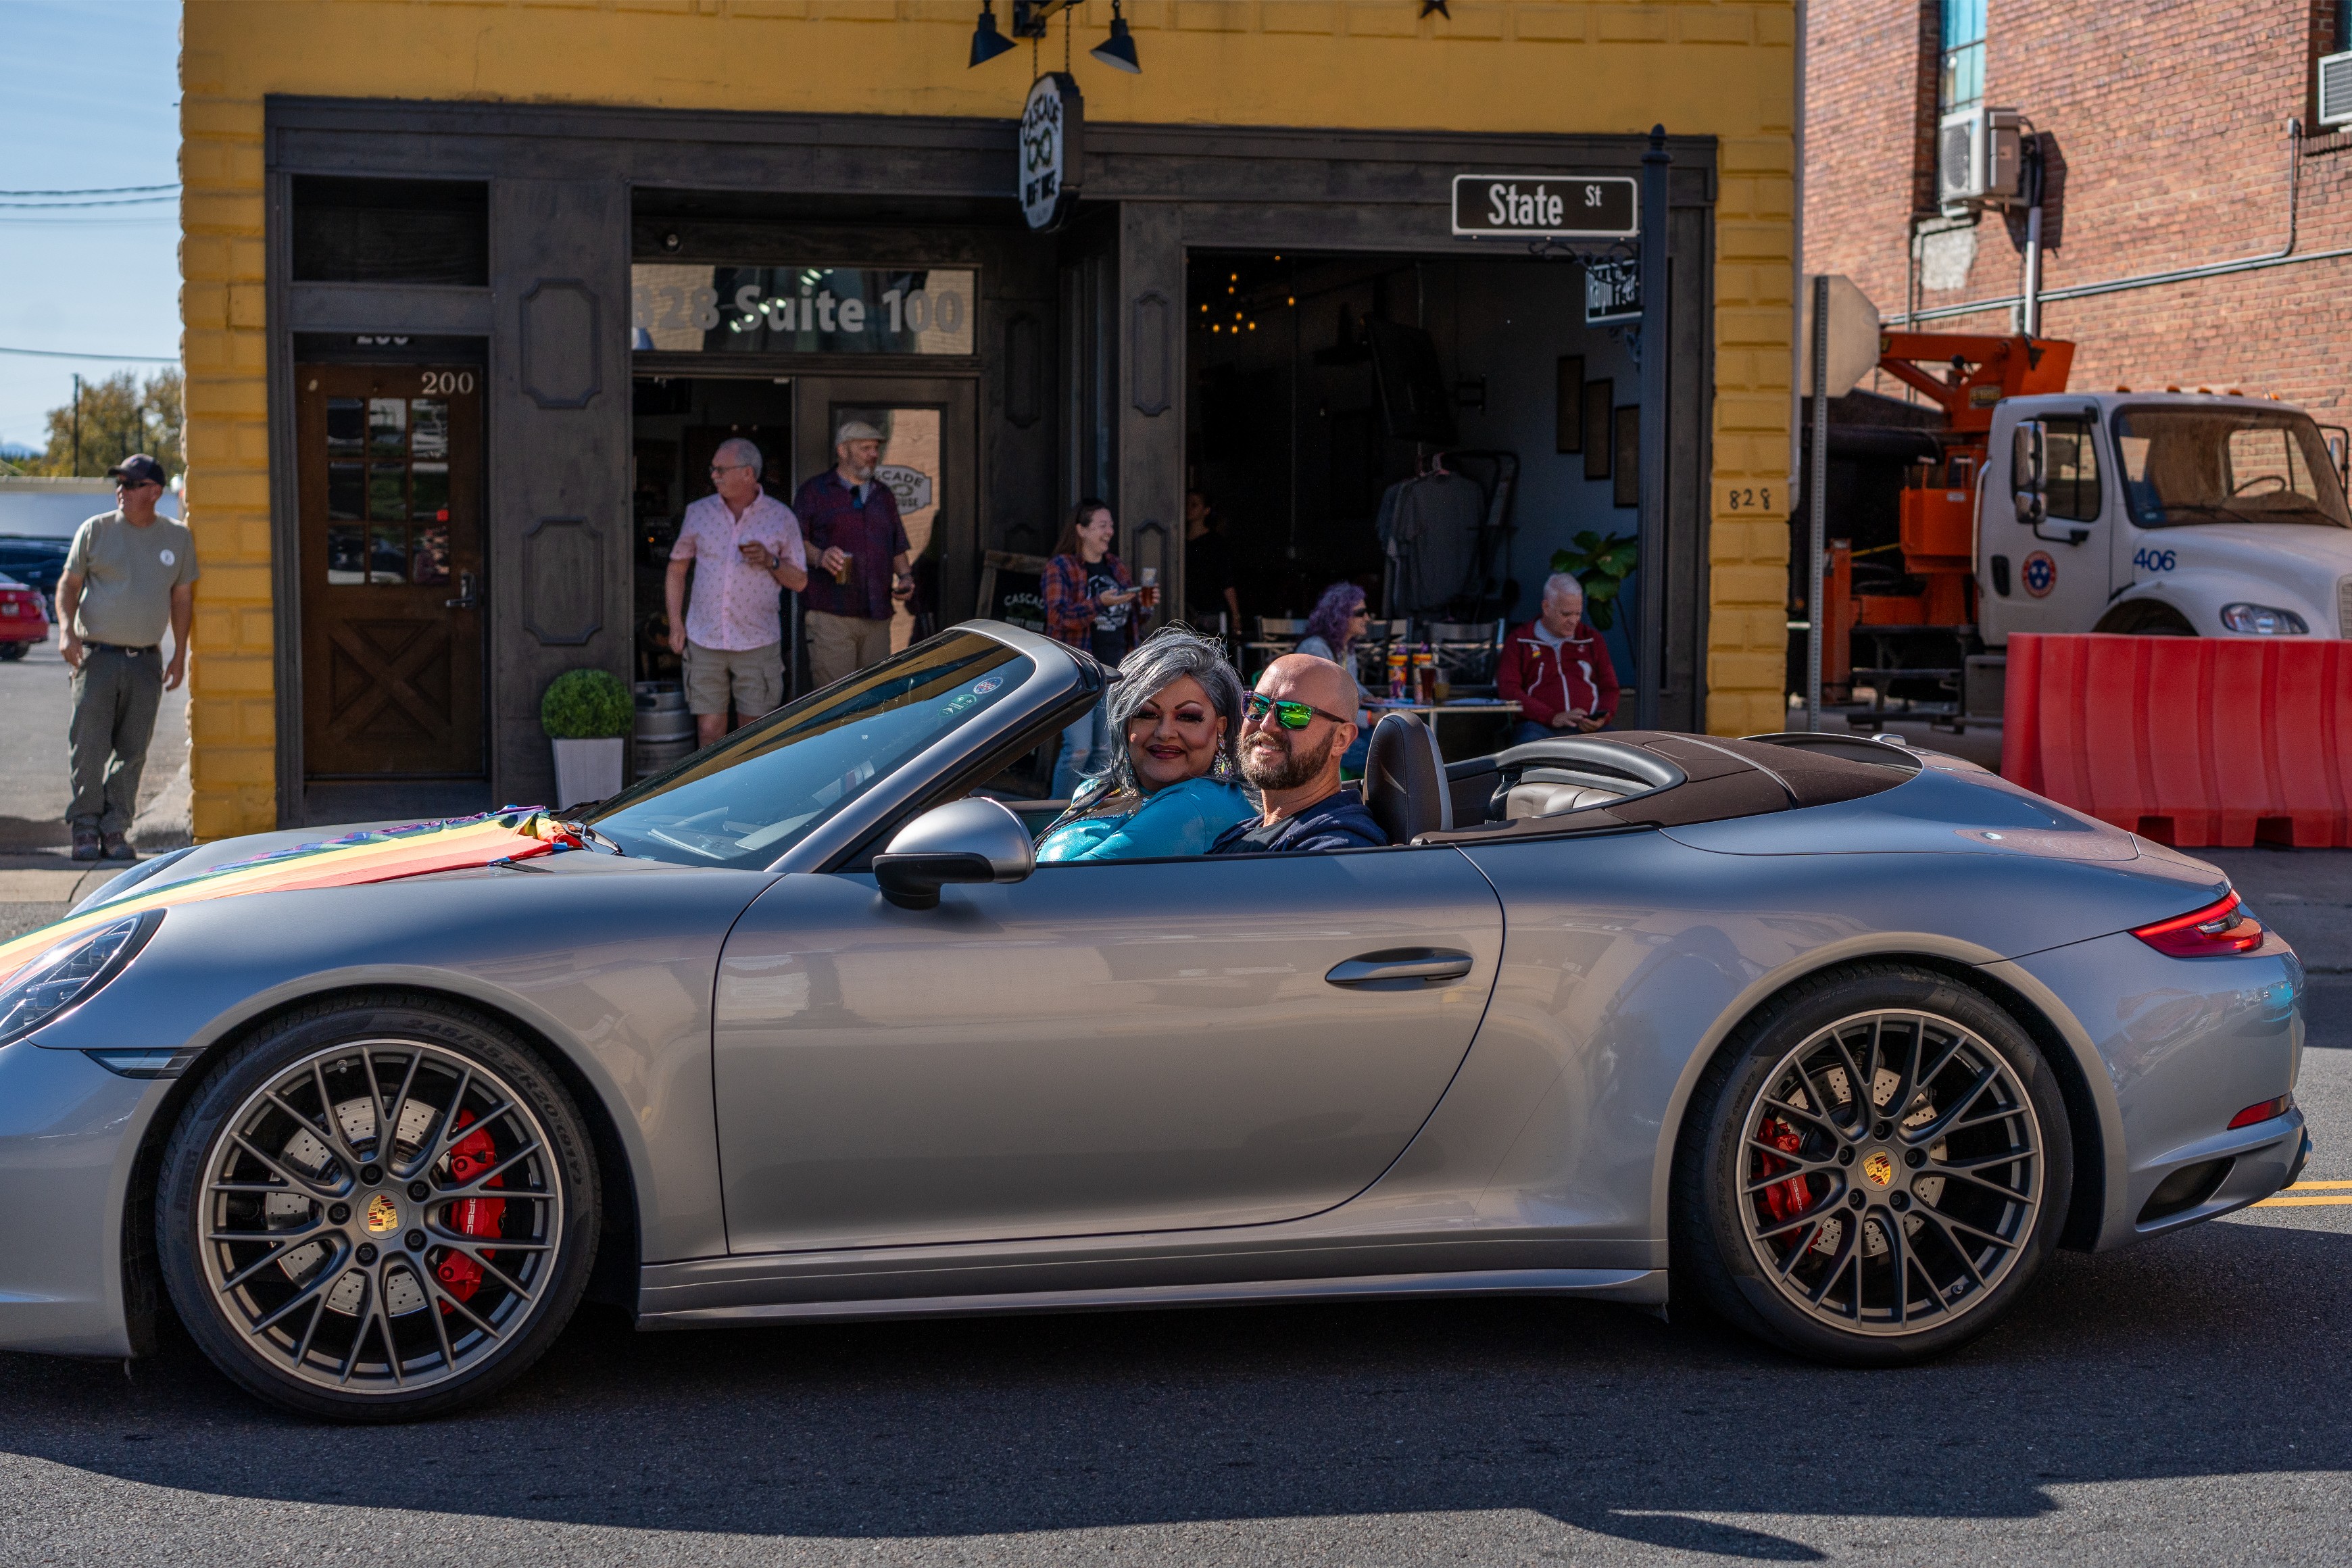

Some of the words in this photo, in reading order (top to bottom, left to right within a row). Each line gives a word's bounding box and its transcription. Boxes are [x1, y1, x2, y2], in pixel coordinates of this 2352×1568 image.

[1488, 183, 1564, 227] State
[1585, 185, 1602, 207] St
[632, 285, 720, 331] 828
[734, 285, 866, 333] Suite
[882, 289, 963, 333] 100
[421, 371, 474, 395] 200
[1729, 487, 1771, 510] 828
[2134, 547, 2176, 571] 406
